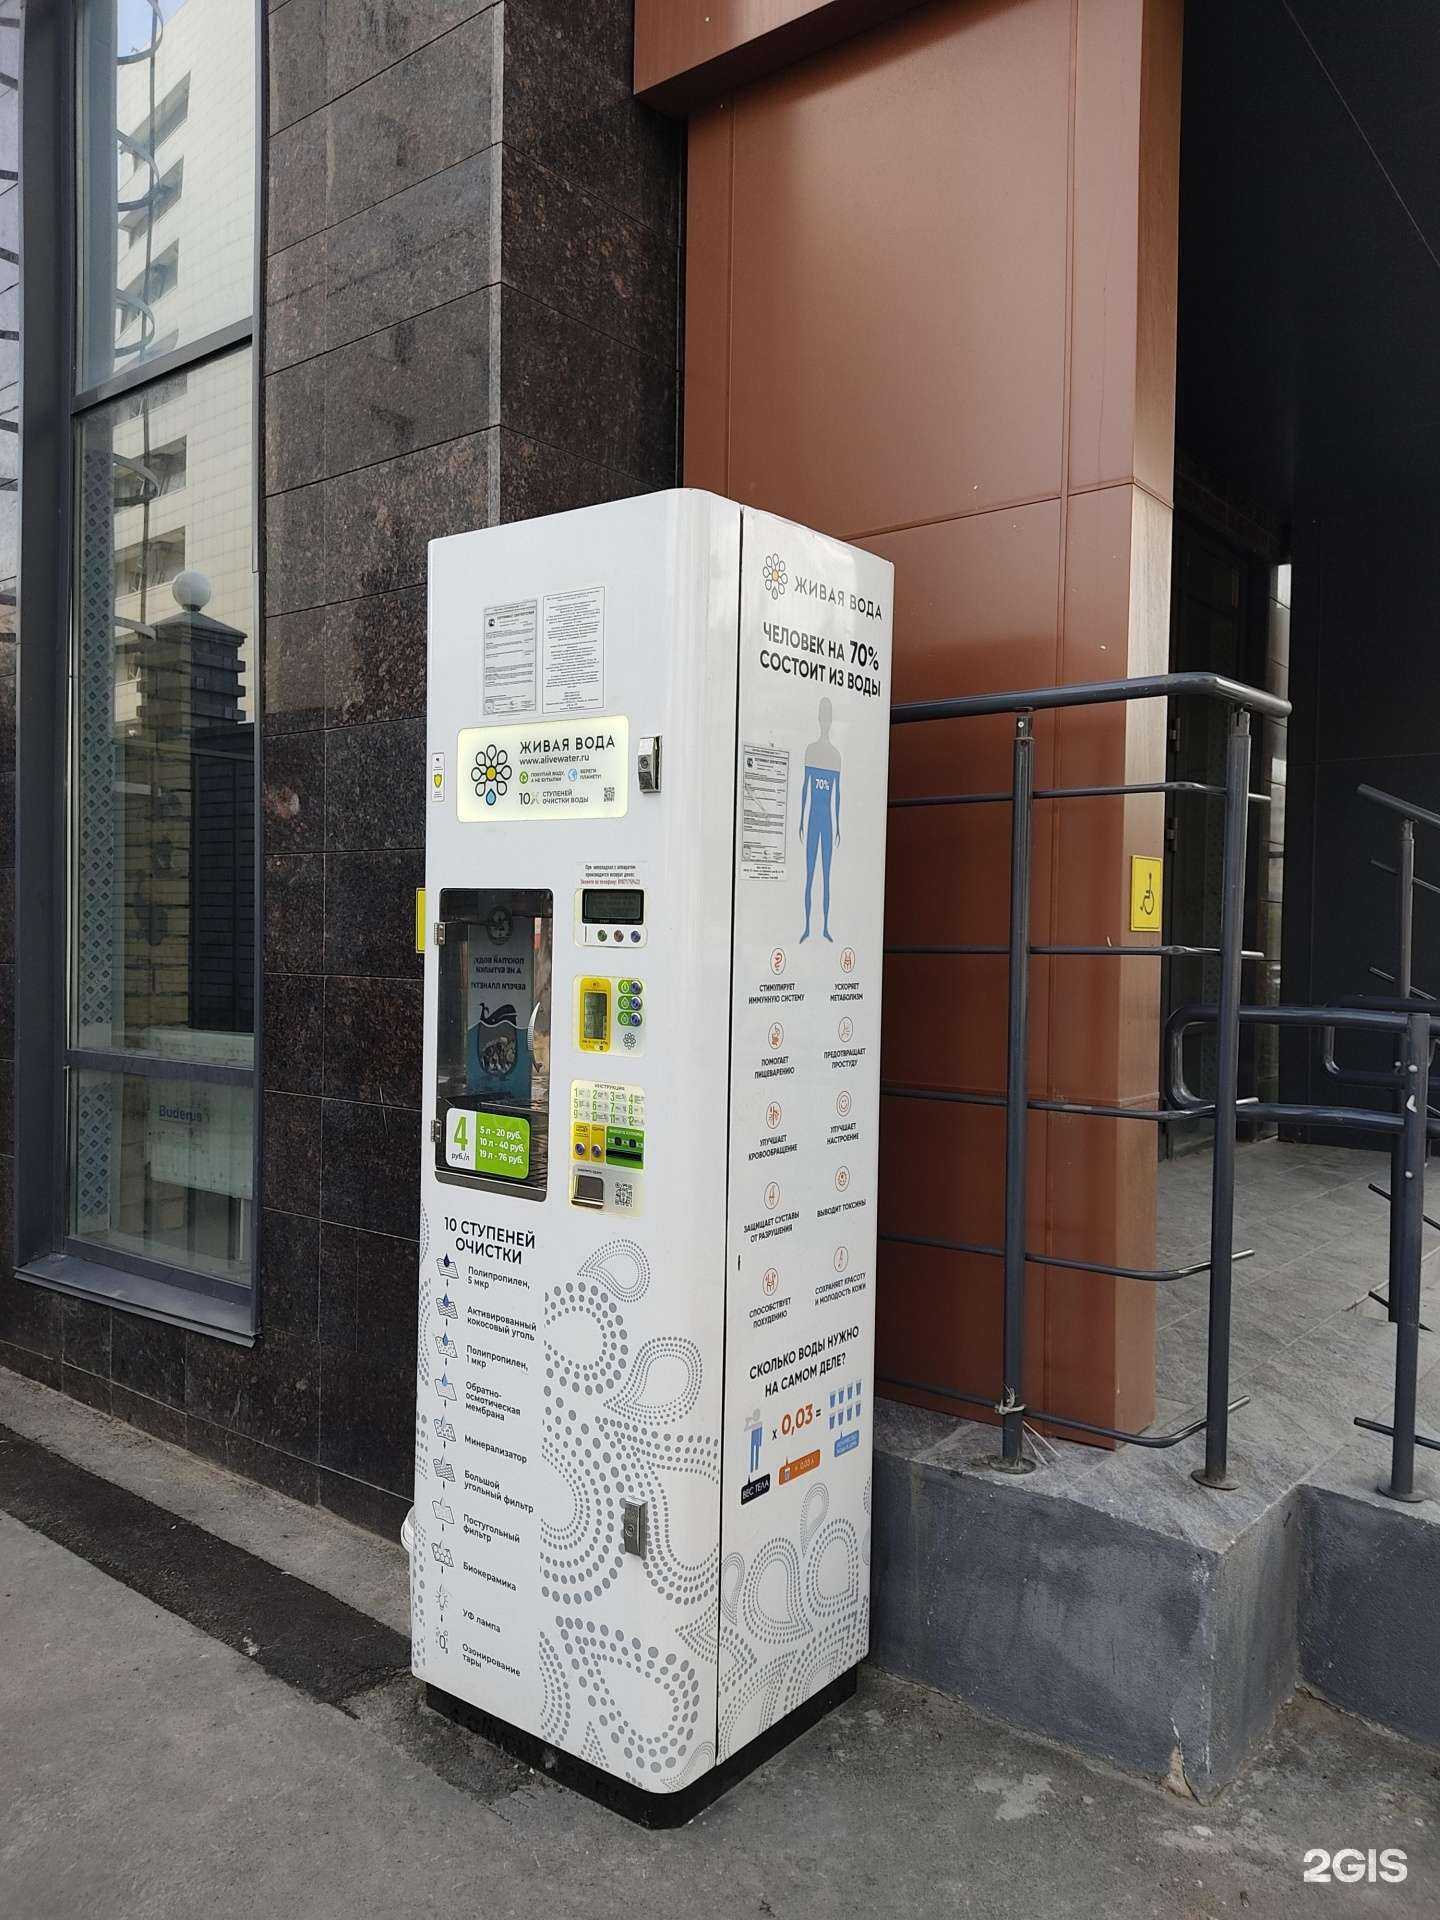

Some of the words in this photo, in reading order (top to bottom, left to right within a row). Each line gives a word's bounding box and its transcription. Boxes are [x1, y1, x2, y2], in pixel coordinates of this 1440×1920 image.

[794, 575, 845, 607] ЖИВАЯ
[850, 594, 883, 621] ВОДА
[763, 621, 825, 656] ЧЕЛОВЕК
[828, 640, 845, 661] НА
[850, 640, 879, 671] 70%
[760, 649, 826, 682] СОСТОИТ
[829, 667, 844, 687] ИЗ
[847, 672, 881, 698] ВОДЫ
[519, 738, 570, 755] ЖИВАЯ
[575, 735, 616, 750] ВОДА
[519, 754, 590, 766] www.alivewater.ru
[543, 789, 573, 797] СТУПЕНЕЙ
[815, 778, 830, 791] 70%
[519, 792, 531, 805] 10
[543, 797, 570, 805] ОЧИСТКИ
[571, 796, 589, 804] ВОДЫ
[759, 983, 796, 992] СТИМУЛИРУЕТ
[834, 982, 860, 991] УСКОРЯЕТ
[748, 995, 780, 1005] ИММУННУЮ
[781, 994, 805, 1003] СИСТЕМУ
[830, 993, 864, 1002] МЕТАБОЛИЗМ
[761, 1056, 789, 1067] ПОМОГАЕТ
[823, 1048, 866, 1059] ПРЕДОТВРАЩАЕТ
[755, 1067, 795, 1079] ПИЩЕВАРЕНИЮ
[831, 1060, 858, 1069] ПРОСТУДУ
[453, 1115, 469, 1152] 4
[480, 1126, 485, 1134] 5
[496, 1128, 505, 1137] 20
[506, 1130, 522, 1140] руб.
[830, 1122, 857, 1133] УЛУЧШАЕТ
[480, 1138, 487, 1146] 10
[499, 1141, 508, 1150] 40
[510, 1143, 525, 1153] руб.
[760, 1134, 787, 1147] УЛУЧШАЕТ
[826, 1133, 859, 1145] НАСТРОЕНИЕ
[508, 1156, 524, 1165] руб.
[748, 1144, 798, 1161] КРОВООБРАЩЕНИЕ
[816, 1204, 841, 1218] ВЫВОДИТ
[842, 1199, 867, 1211] ТОКСИНЫ
[743, 1217, 775, 1233] ЗАЩИЩАЕТ
[775, 1211, 800, 1224] СУСТАВЫ
[444, 1216, 457, 1232] 10
[460, 1220, 536, 1249] СТУПЕНЕЙ
[750, 1233, 758, 1243] ОТ
[758, 1224, 793, 1241] РАЗРУШЕНИЯ
[455, 1237, 522, 1265] ОЧИСТКИ
[467, 1276, 472, 1284] 5
[473, 1279, 490, 1290] мкр
[468, 1265, 530, 1290] Полипропилен,
[815, 1279, 844, 1295] СОХРАНЯЕТ
[844, 1272, 867, 1286] КРАСОТУ
[819, 1288, 851, 1305] МОЛОДОСТЬ
[852, 1282, 867, 1294] КОЖИ
[749, 1297, 792, 1319] СПОСОБСТВУЕТ
[467, 1305, 537, 1332] Активированный
[753, 1310, 788, 1328] ПОХУДЕНИЮ
[467, 1317, 510, 1335] кокосовый
[511, 1329, 535, 1341] уголь
[466, 1344, 529, 1372] Полипропилен,
[466, 1354, 470, 1363] 1
[471, 1358, 487, 1369] мкр
[749, 1350, 796, 1380] СКОЛЬКО
[798, 1339, 826, 1361] ВОДЫ
[827, 1325, 860, 1348] НУЖНО
[765, 1381, 779, 1398] НА
[781, 1364, 818, 1390] САМОМ
[819, 1352, 846, 1376] ДЕЛЕ?
[465, 1381, 502, 1398] Обратно-
[465, 1392, 521, 1416] осмотическая
[465, 1402, 505, 1421] мембрана
[781, 1403, 813, 1436] 0,03
[464, 1434, 528, 1464] Минерализатор
[464, 1470, 500, 1490] Большой
[464, 1480, 502, 1501] угольный
[503, 1494, 535, 1514] фильтр
[742, 1487, 754, 1500] ВЕС
[755, 1480, 770, 1494] ТЕЛА
[463, 1513, 520, 1543] Постугольный
[463, 1524, 492, 1543] фильтр
[463, 1561, 517, 1591] Биокерамика
[462, 1608, 475, 1621] УФ
[476, 1617, 501, 1633] лампа
[462, 1643, 521, 1677] Озонирование
[462, 1653, 482, 1669] тары
